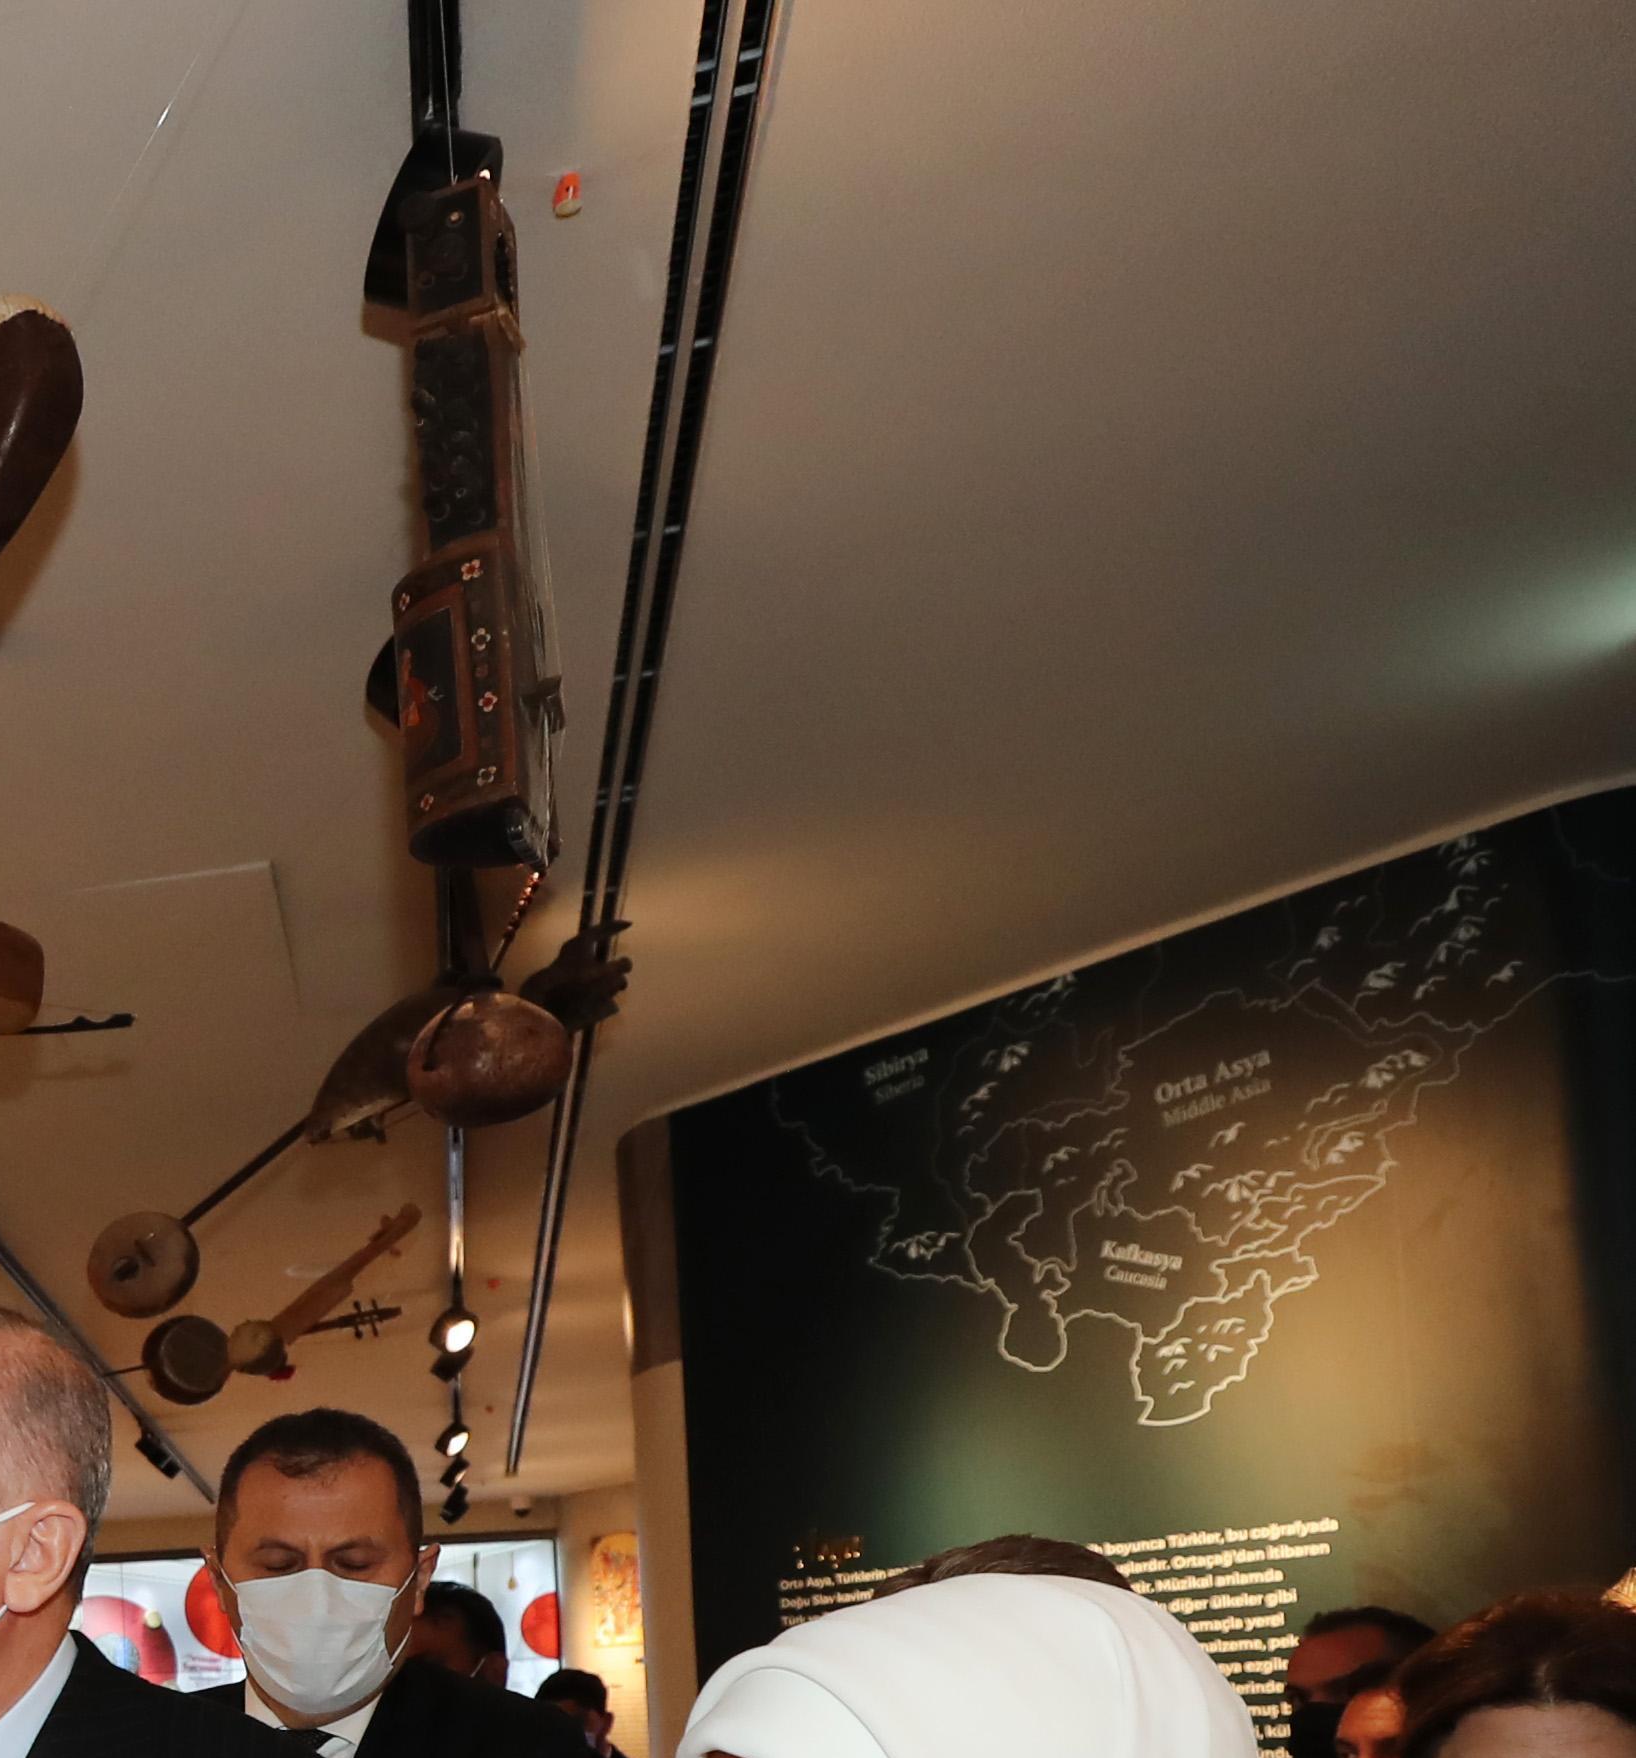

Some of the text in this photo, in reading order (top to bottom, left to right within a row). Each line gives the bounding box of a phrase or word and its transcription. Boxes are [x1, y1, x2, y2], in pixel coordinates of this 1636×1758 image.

[864, 1047, 928, 1086] Sibirya
[1154, 1049, 1270, 1105] Orta Asya
[1162, 1094, 1226, 1128] Middle
[1100, 1239, 1183, 1273] Kafkasya
[1104, 1264, 1167, 1290] Caucasia
[1104, 1537, 1166, 1557] boyunca
[1225, 1527, 1248, 1543] bu
[780, 1579, 804, 1590] Orta
[835, 1568, 886, 1585] Türklerin
[1155, 1574, 1213, 1592] Müzikal
[1214, 1567, 1284, 1587] anlamda
[781, 1597, 811, 1609] Doğu
[1169, 1588, 1297, 1614] diğer ülkeler gibi
[1188, 1611, 1286, 1633] amaçla yerel
[1268, 1633, 1300, 1652] pek
